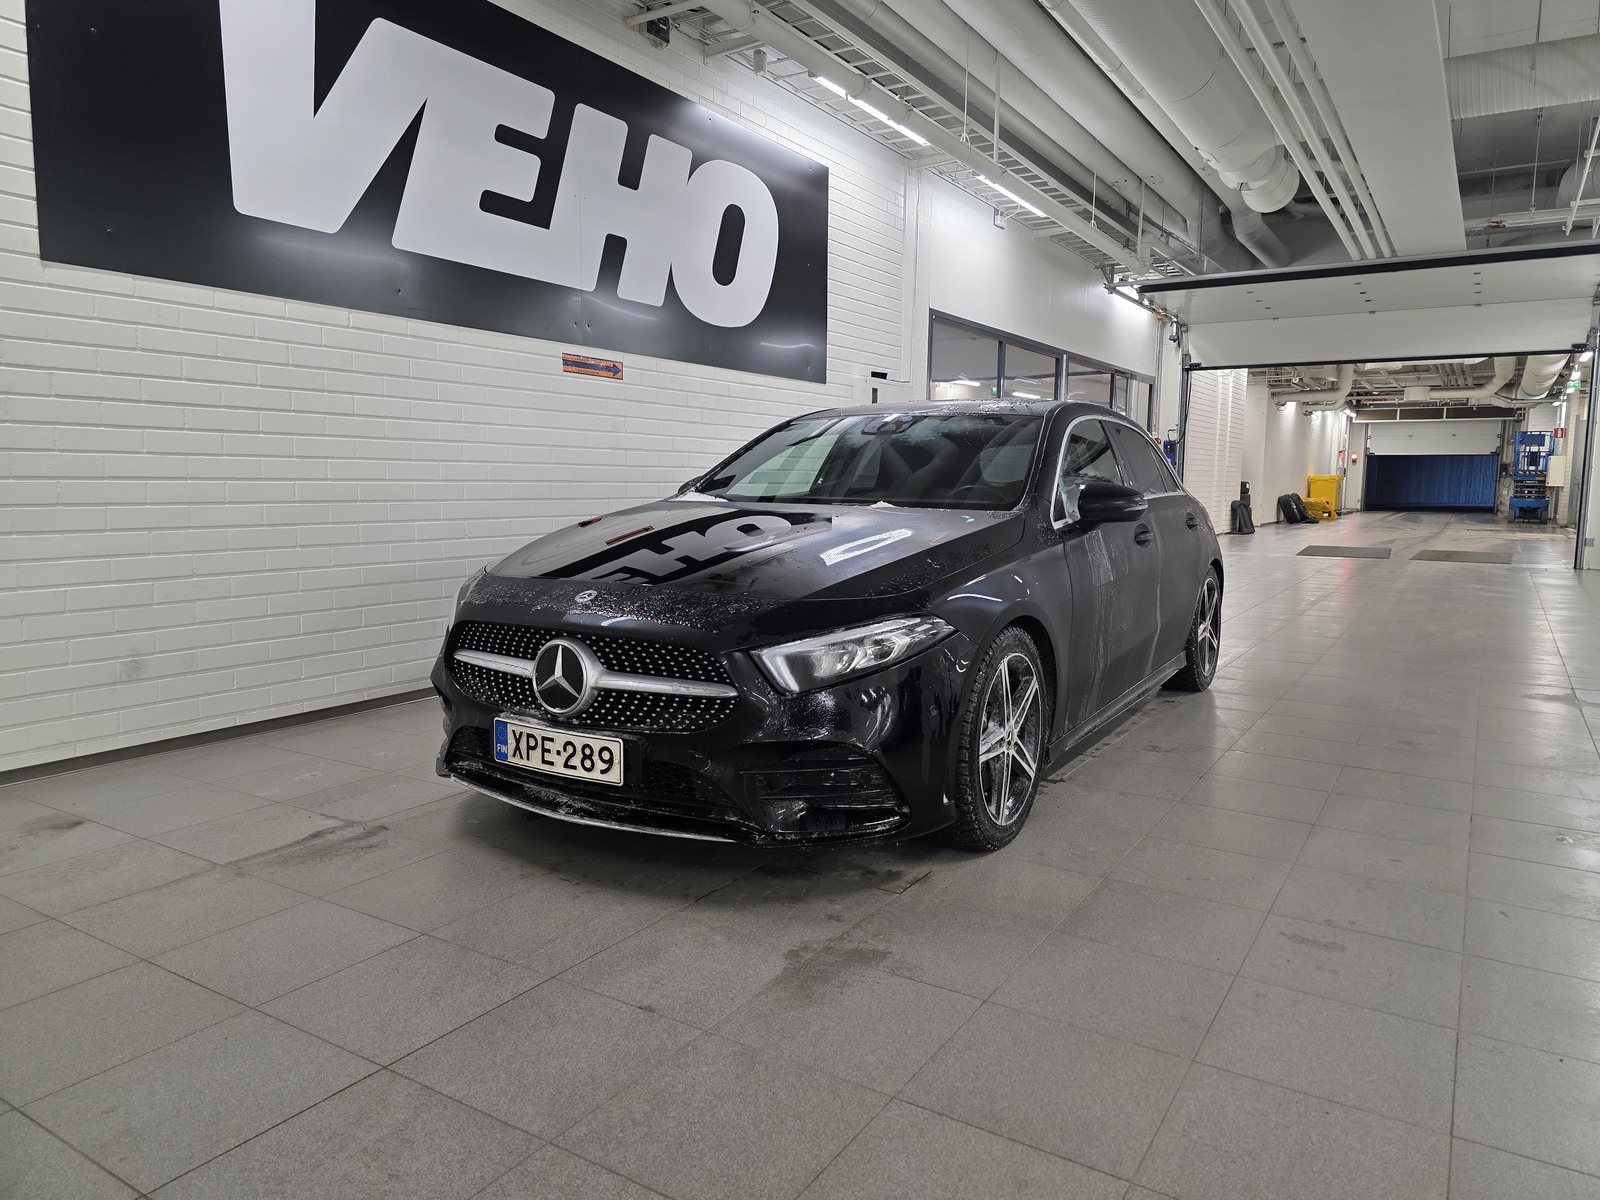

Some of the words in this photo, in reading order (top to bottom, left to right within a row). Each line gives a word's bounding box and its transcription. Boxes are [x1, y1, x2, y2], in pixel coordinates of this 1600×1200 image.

[220, 0, 779, 328] VEHO
[496, 743, 508, 754] FIN
[511, 729, 614, 775] XPE-289
